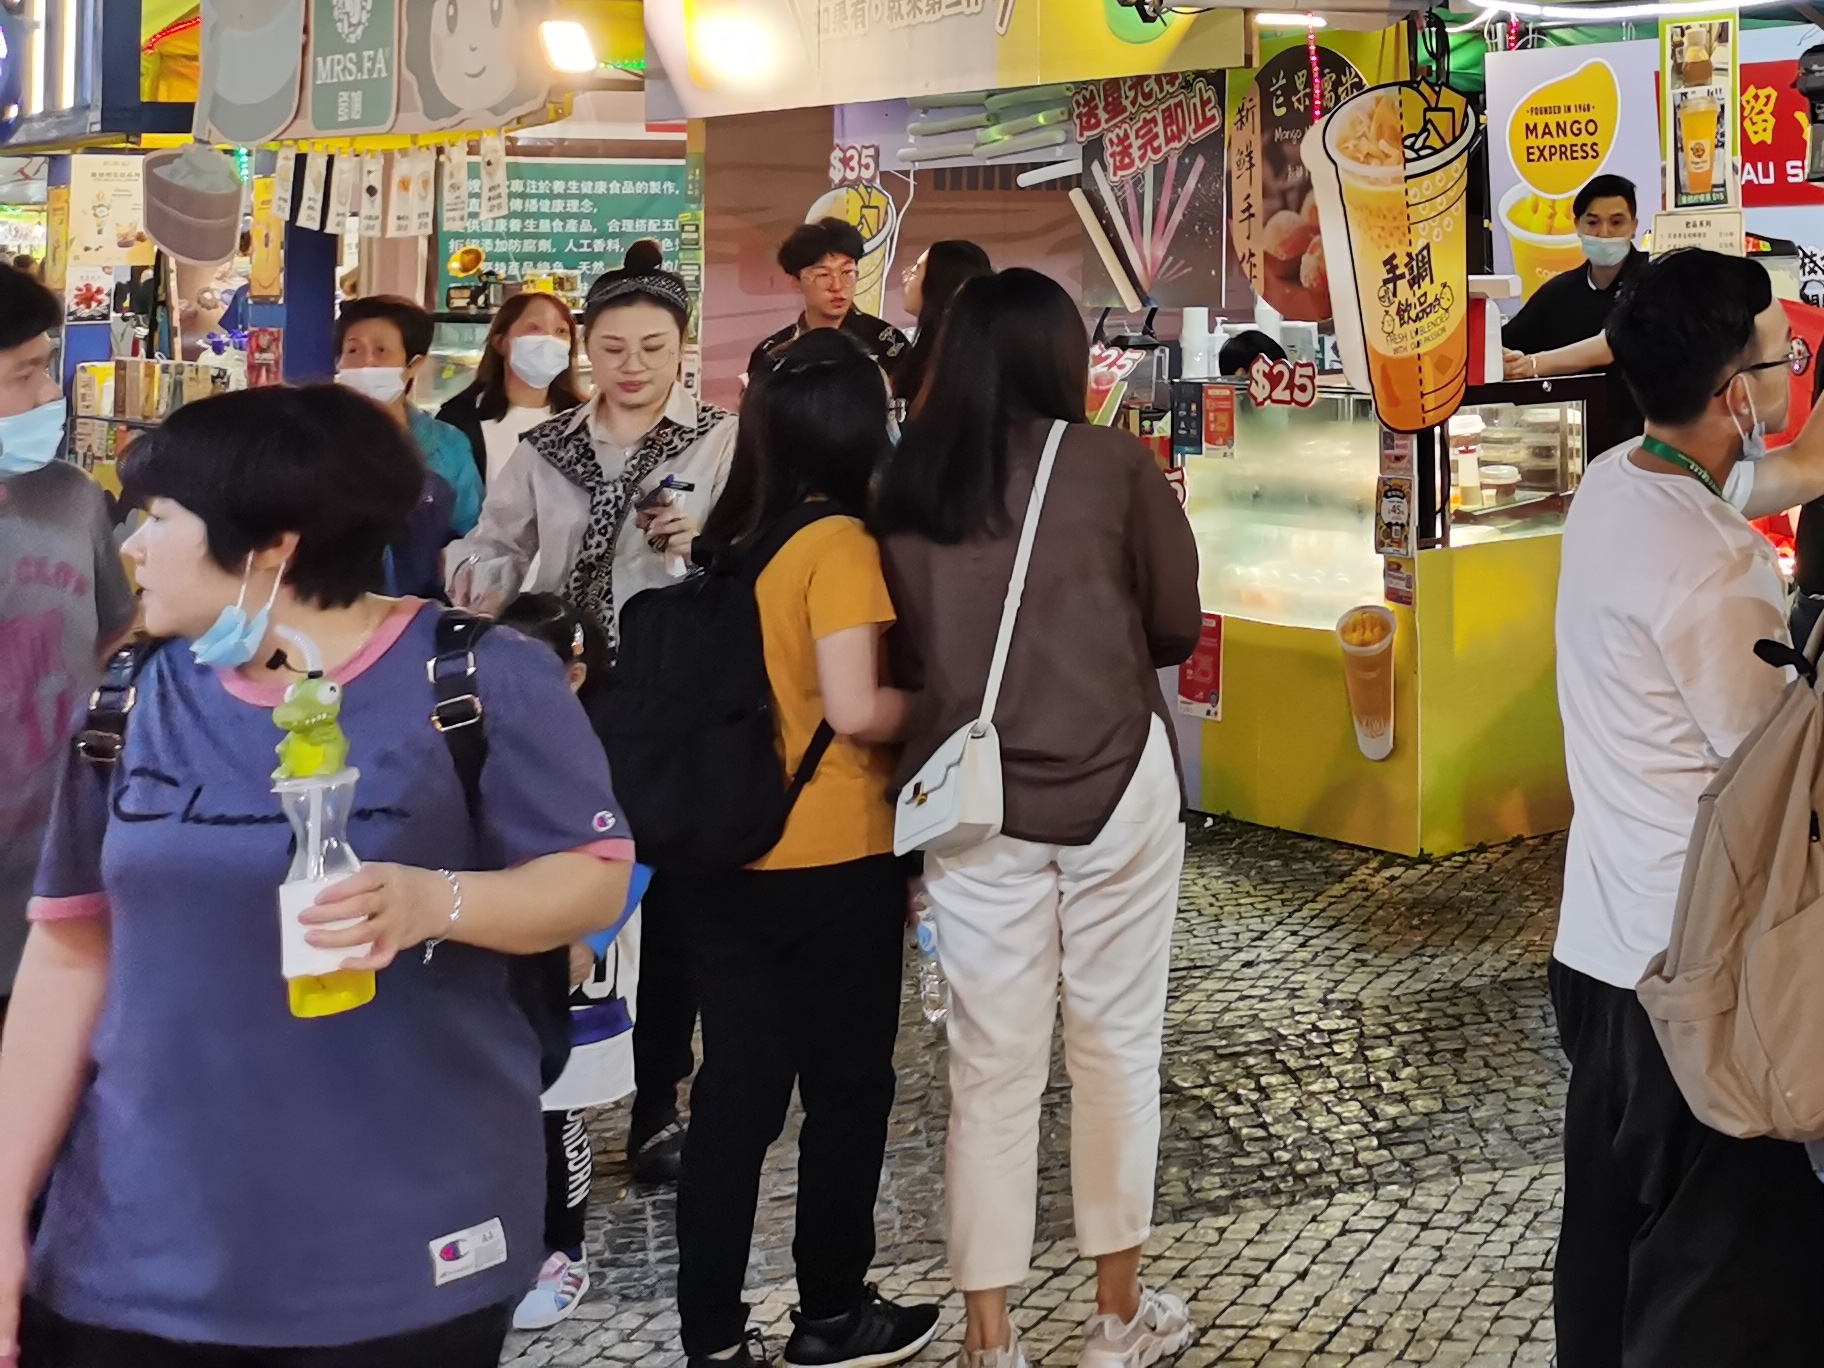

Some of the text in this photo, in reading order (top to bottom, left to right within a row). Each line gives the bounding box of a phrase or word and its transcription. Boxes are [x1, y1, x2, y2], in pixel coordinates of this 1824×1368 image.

[1530, 105, 1562, 116] FOUNDED
[1574, 103, 1591, 114] 1960
[1108, 85, 1218, 178] 送完即止
[1525, 118, 1599, 140] MANGO
[828, 146, 876, 185] $35
[1526, 141, 1600, 164] EXPRESS
[1250, 355, 1316, 406] $25
